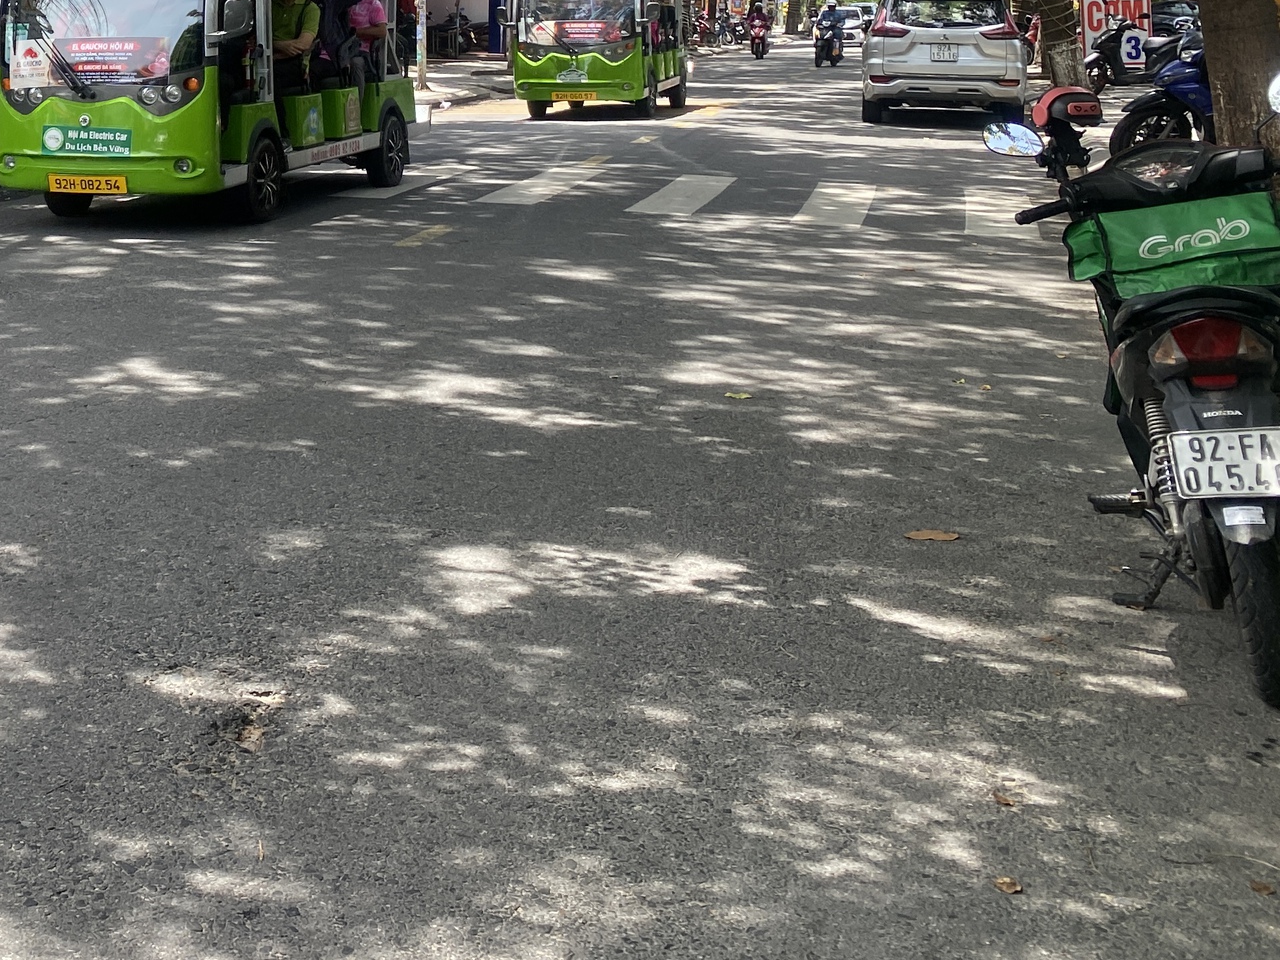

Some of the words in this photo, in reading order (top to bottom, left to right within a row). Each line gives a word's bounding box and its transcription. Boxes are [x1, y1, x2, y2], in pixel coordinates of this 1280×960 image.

[71, 43, 79, 51] EL
[80, 43, 108, 51] GAUCHO
[123, 42, 134, 50] AN
[936, 44, 952, 52] 92A
[67, 129, 79, 139] Hội
[79, 130, 88, 139] An
[89, 131, 114, 141] Electric
[115, 132, 128, 141] Car
[65, 142, 76, 150] Du
[76, 143, 92, 152] Lịch
[93, 142, 108, 152] Bền
[109, 144, 130, 155] Vững
[54, 178, 120, 190] 92H-082.54
[1138, 217, 1251, 259] Grab
[1203, 409, 1243, 418] HONDA
